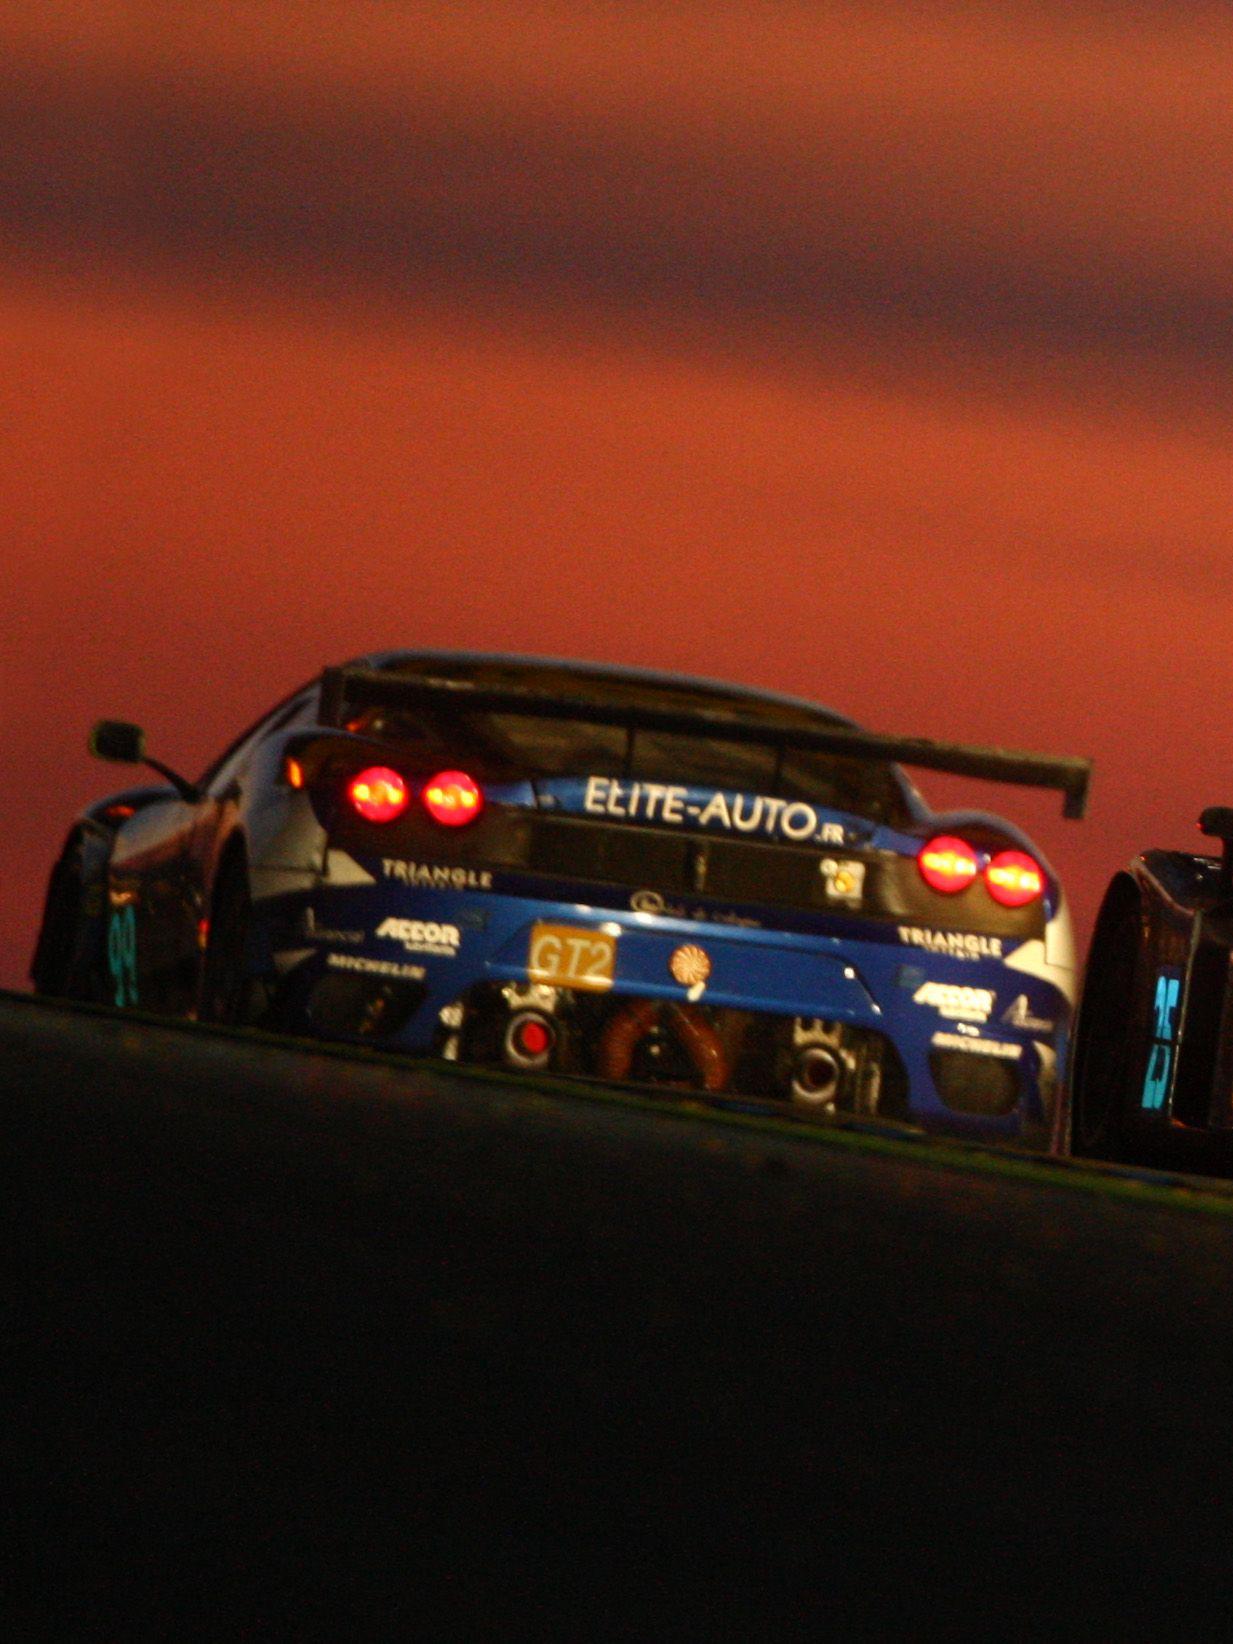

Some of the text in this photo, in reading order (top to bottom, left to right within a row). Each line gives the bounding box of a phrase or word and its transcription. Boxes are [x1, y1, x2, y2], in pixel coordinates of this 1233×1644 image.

[381, 858, 493, 888] TRIANGLE
[897, 925, 1003, 958] TRIANGLE
[530, 933, 613, 984] GT2
